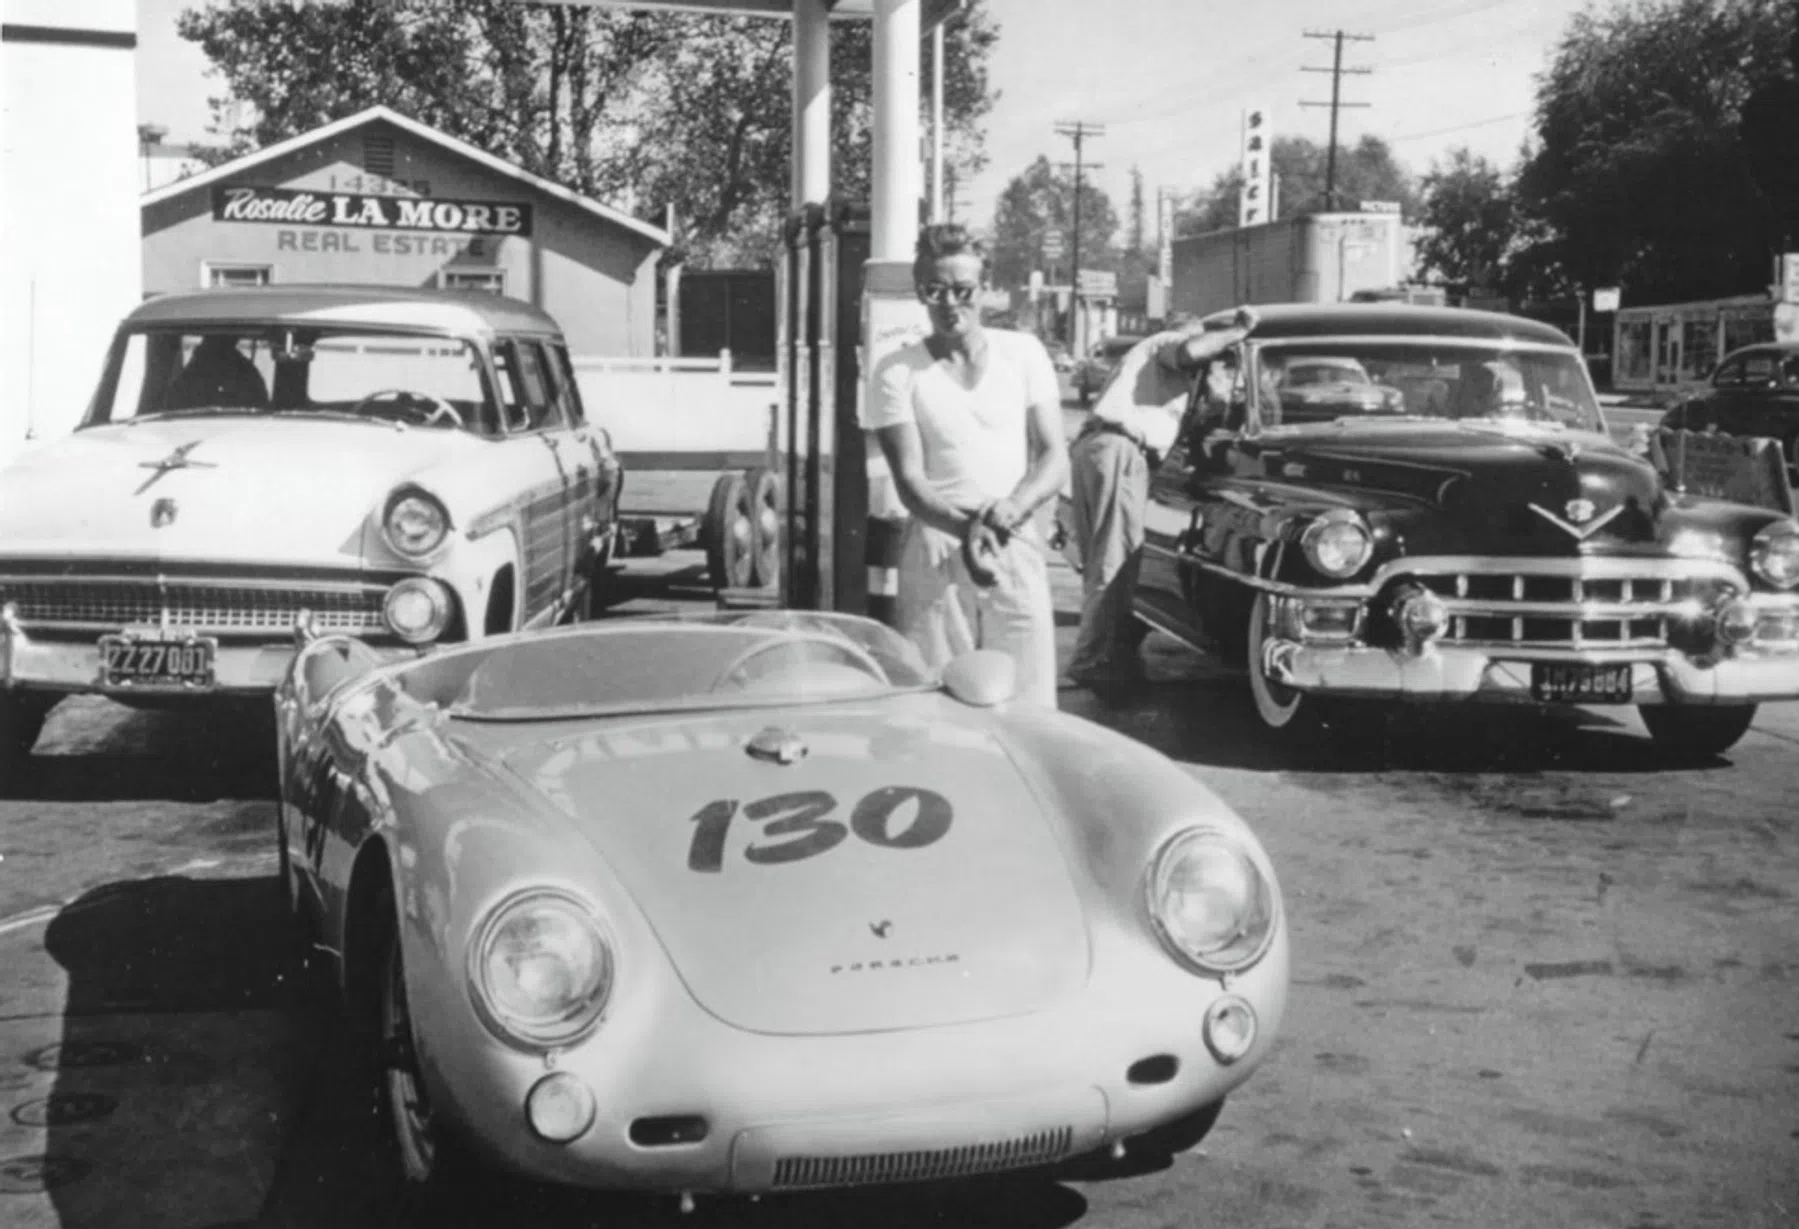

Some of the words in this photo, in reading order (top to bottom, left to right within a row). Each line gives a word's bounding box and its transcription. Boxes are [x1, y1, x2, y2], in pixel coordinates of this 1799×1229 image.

[224, 187, 326, 221] Rosalie
[332, 196, 389, 226] LA
[397, 199, 522, 232] MORE
[278, 230, 360, 252] REAL
[373, 234, 484, 257] ESTATE
[688, 786, 954, 873] 130
